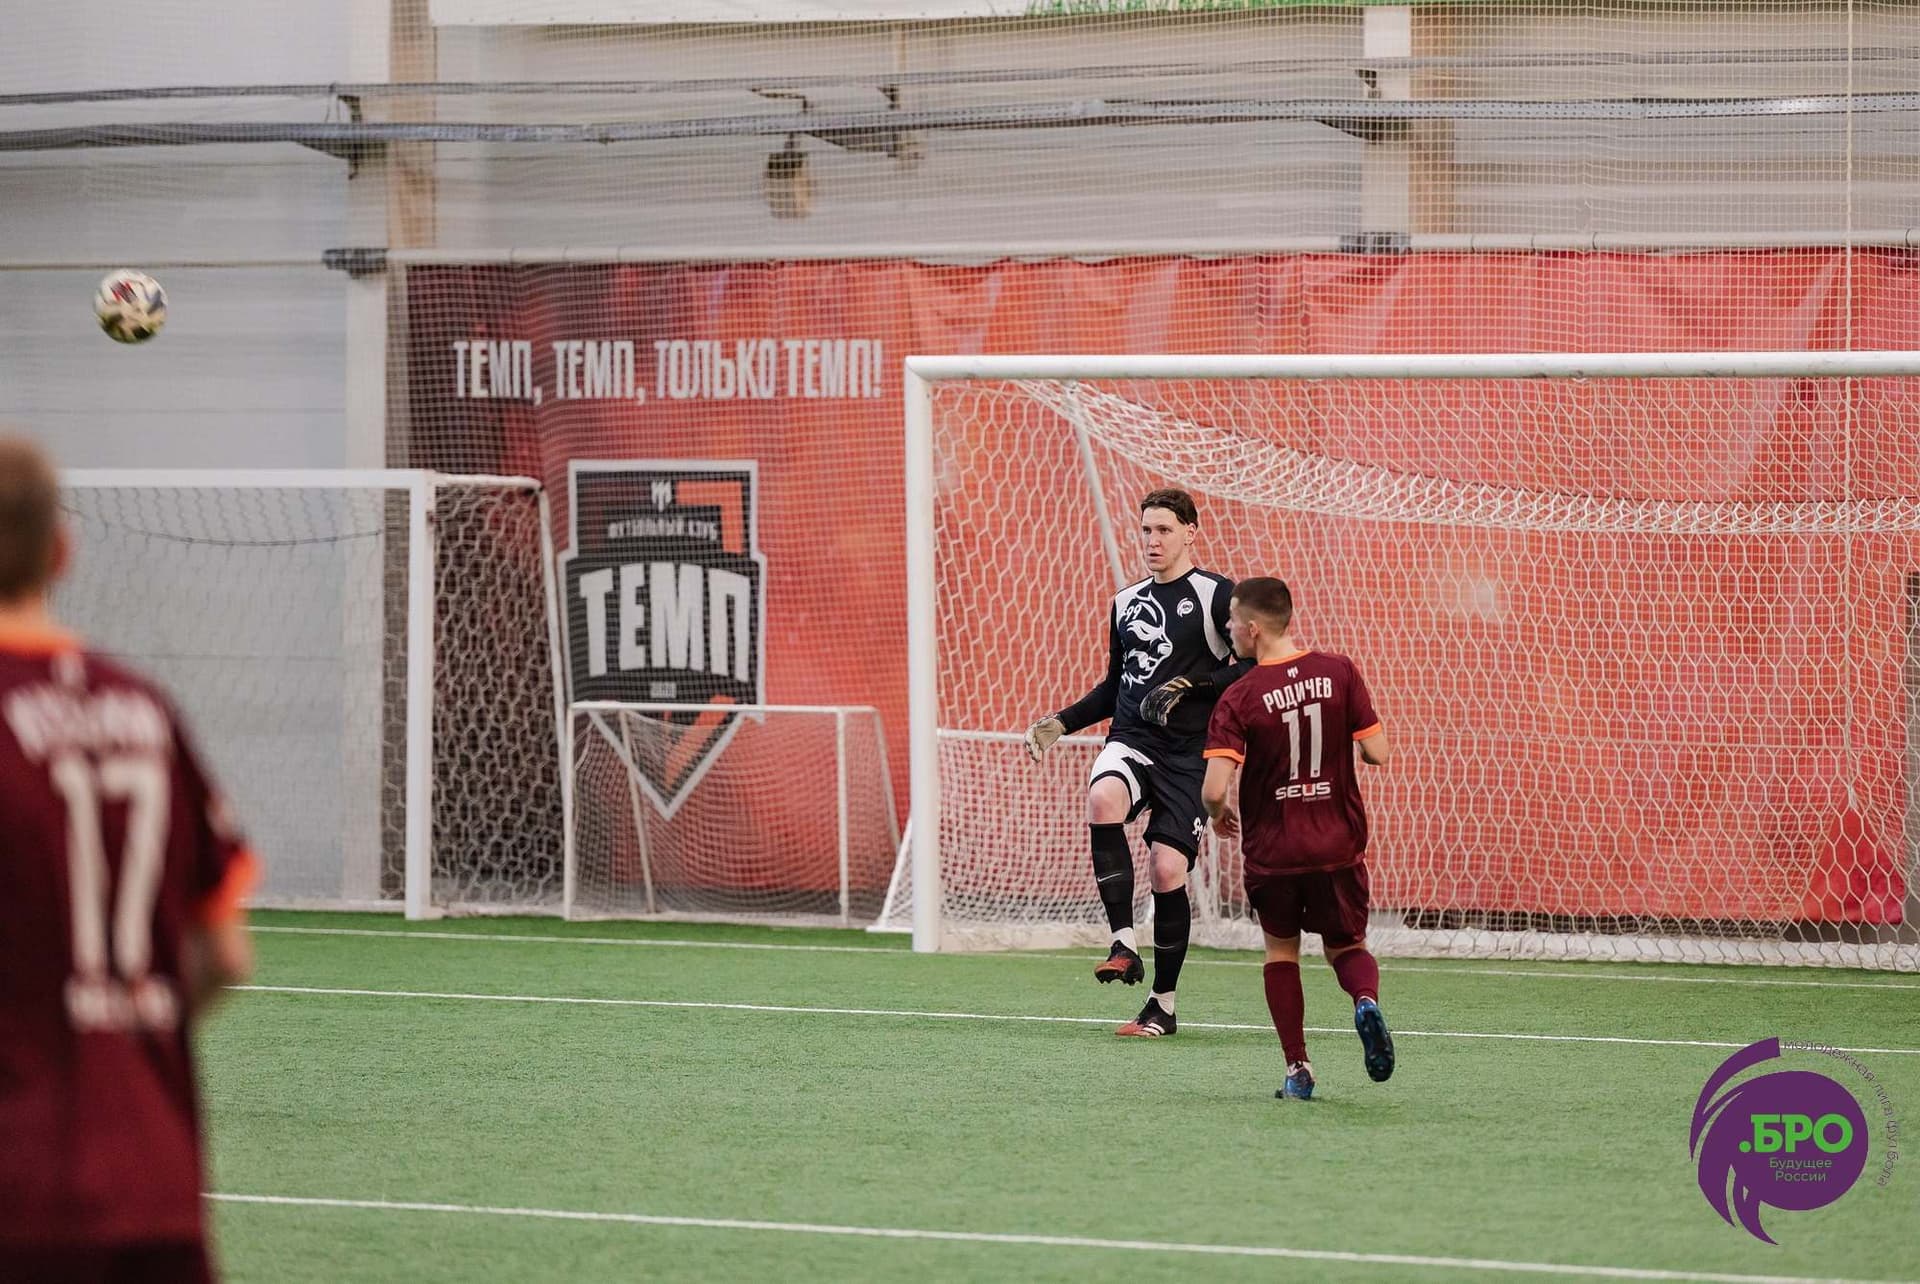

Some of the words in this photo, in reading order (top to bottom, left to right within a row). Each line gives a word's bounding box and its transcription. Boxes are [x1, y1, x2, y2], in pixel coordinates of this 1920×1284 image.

[454, 341, 543, 405] ТЕМП,
[553, 341, 646, 405] ТЕМП,
[654, 339, 777, 400] ТОЛЬКО
[783, 338, 882, 399] ТЕМП!
[579, 561, 750, 683] ТЕМП
[1262, 677, 1333, 713] РОДИЧЕВ
[1281, 702, 1322, 780] 11
[1275, 781, 1331, 800] SEUS
[52, 754, 170, 974] 17
